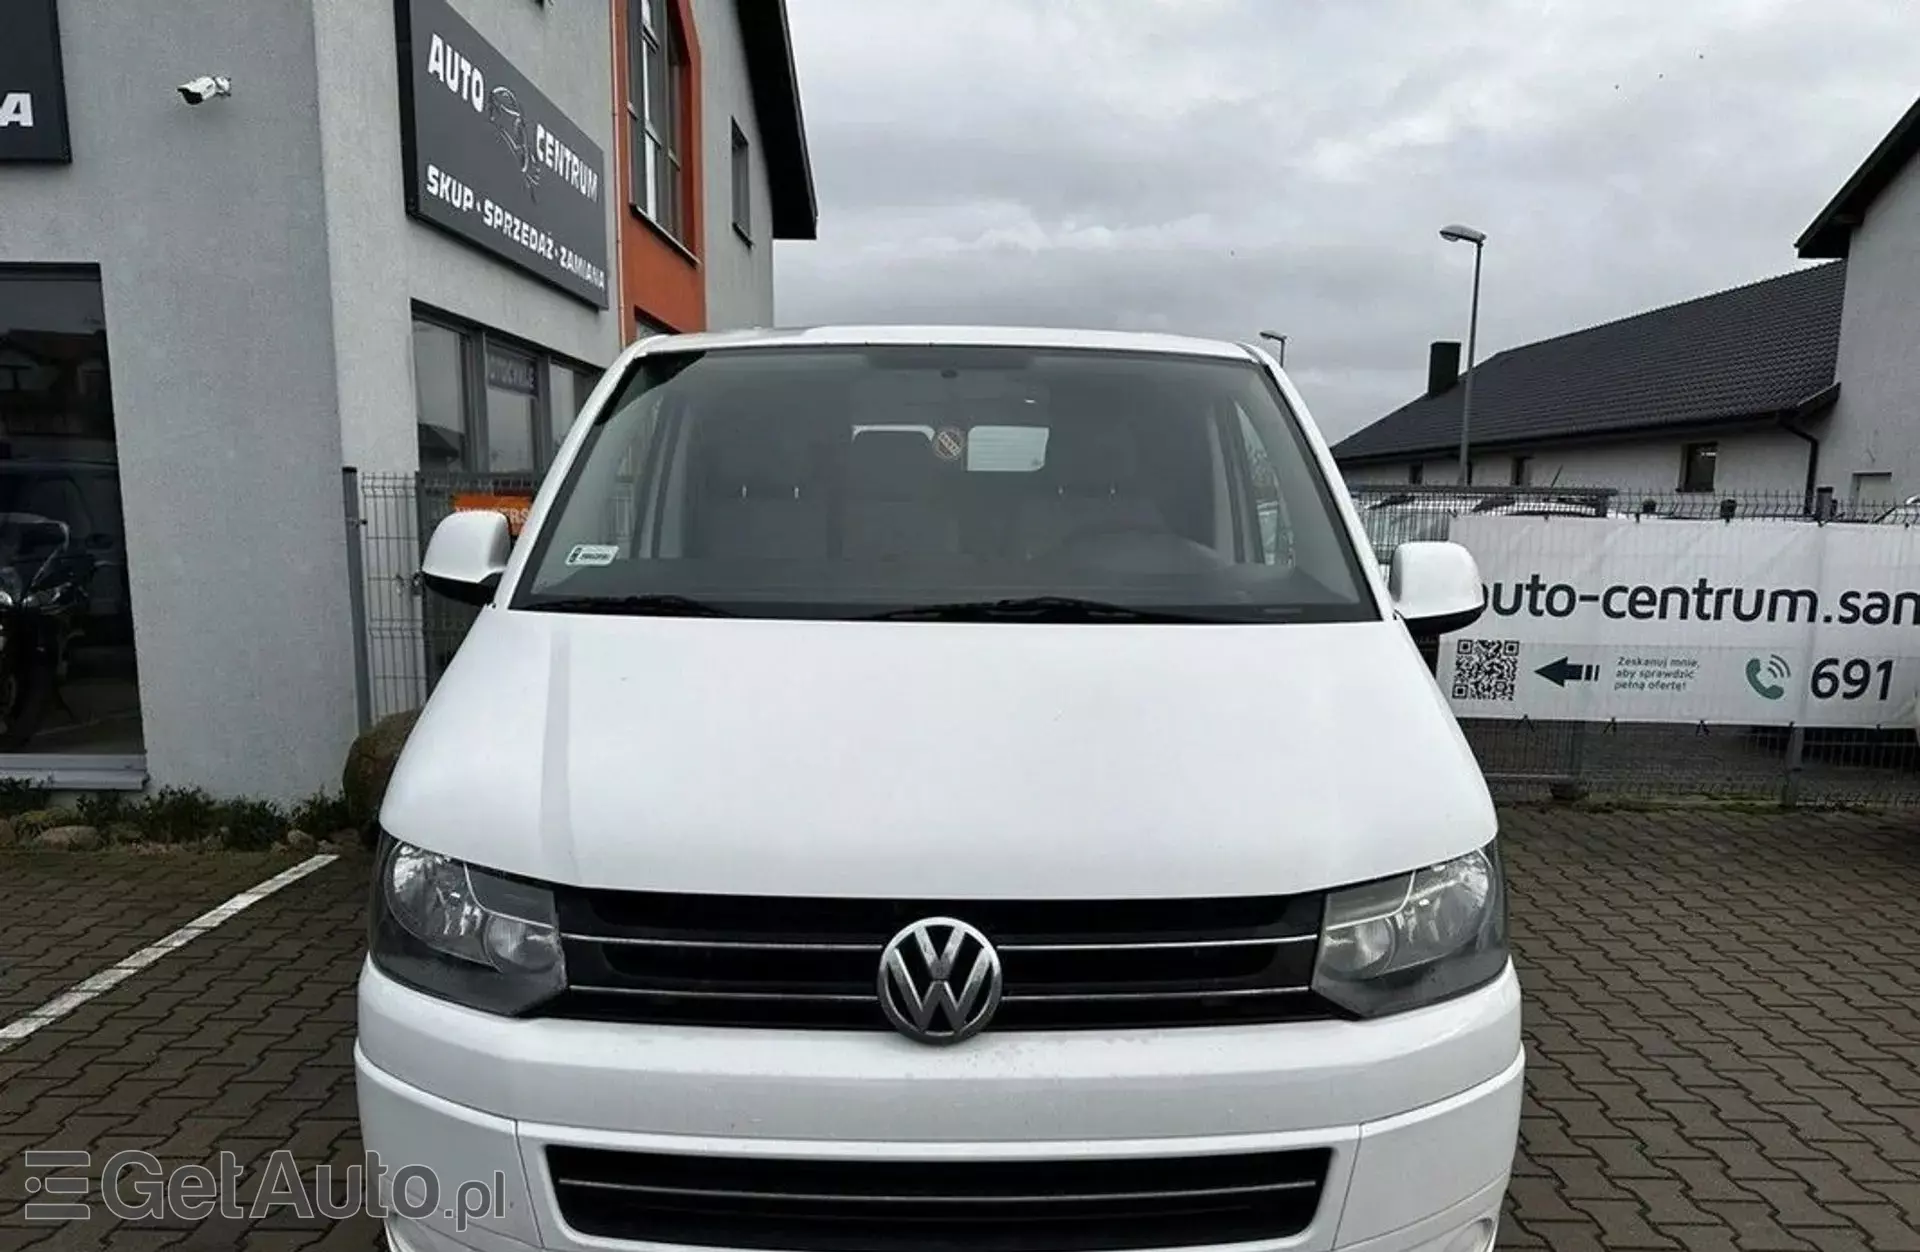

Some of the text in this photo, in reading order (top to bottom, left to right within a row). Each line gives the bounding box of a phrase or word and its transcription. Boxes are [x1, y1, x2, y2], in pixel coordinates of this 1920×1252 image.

[427, 33, 599, 202] AUTO CENTRUM
[426, 163, 474, 212] SKUP
[483, 199, 554, 261] SPRZEDAŻ
[1616, 669, 1637, 679] aby
[1617, 656, 1699, 669] Zeskanuj mnie,
[1810, 657, 1895, 701] 691
